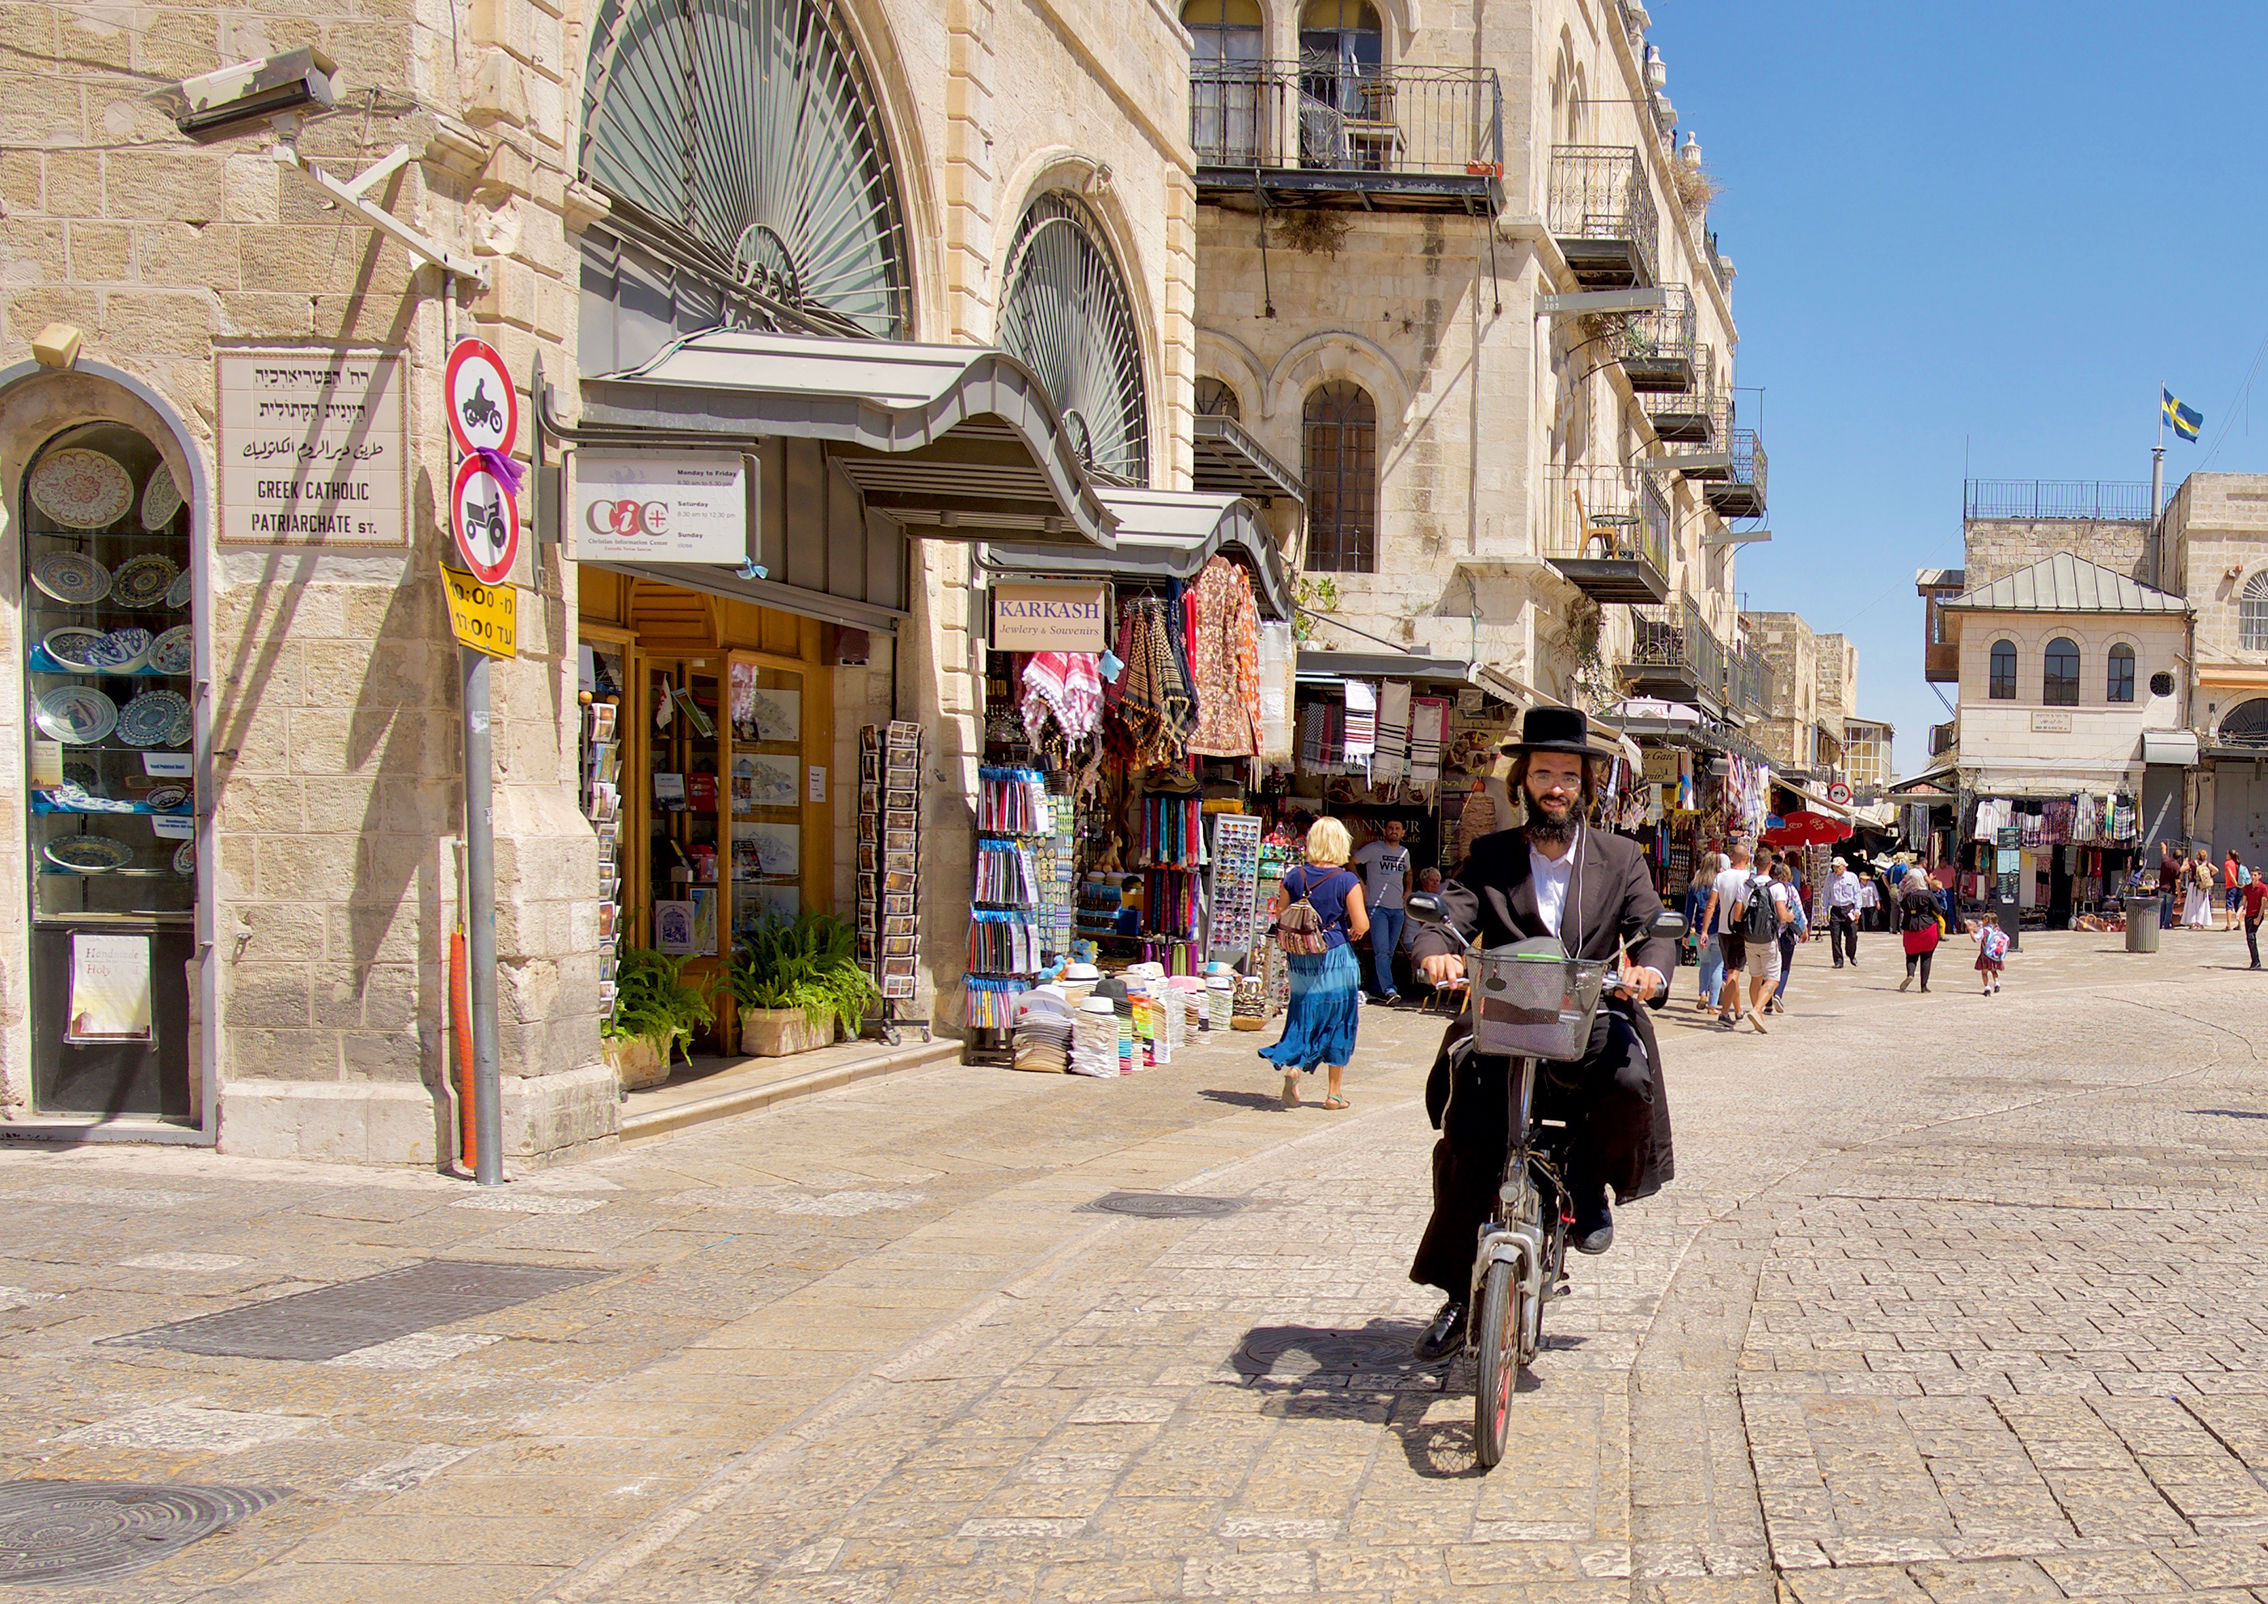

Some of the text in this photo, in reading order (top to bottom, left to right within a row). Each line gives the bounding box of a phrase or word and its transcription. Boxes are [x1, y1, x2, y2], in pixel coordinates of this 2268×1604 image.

[353, 441, 384, 460] طريق
[258, 480, 369, 500] GREEK CATHOLIC
[251, 514, 377, 534] PATRIARCHATE ST.
[999, 601, 1099, 619] KARKASH
[497, 625, 512, 645] עד
[1000, 625, 1039, 636] Jewlery
[1050, 626, 1100, 636] Souvenirs
